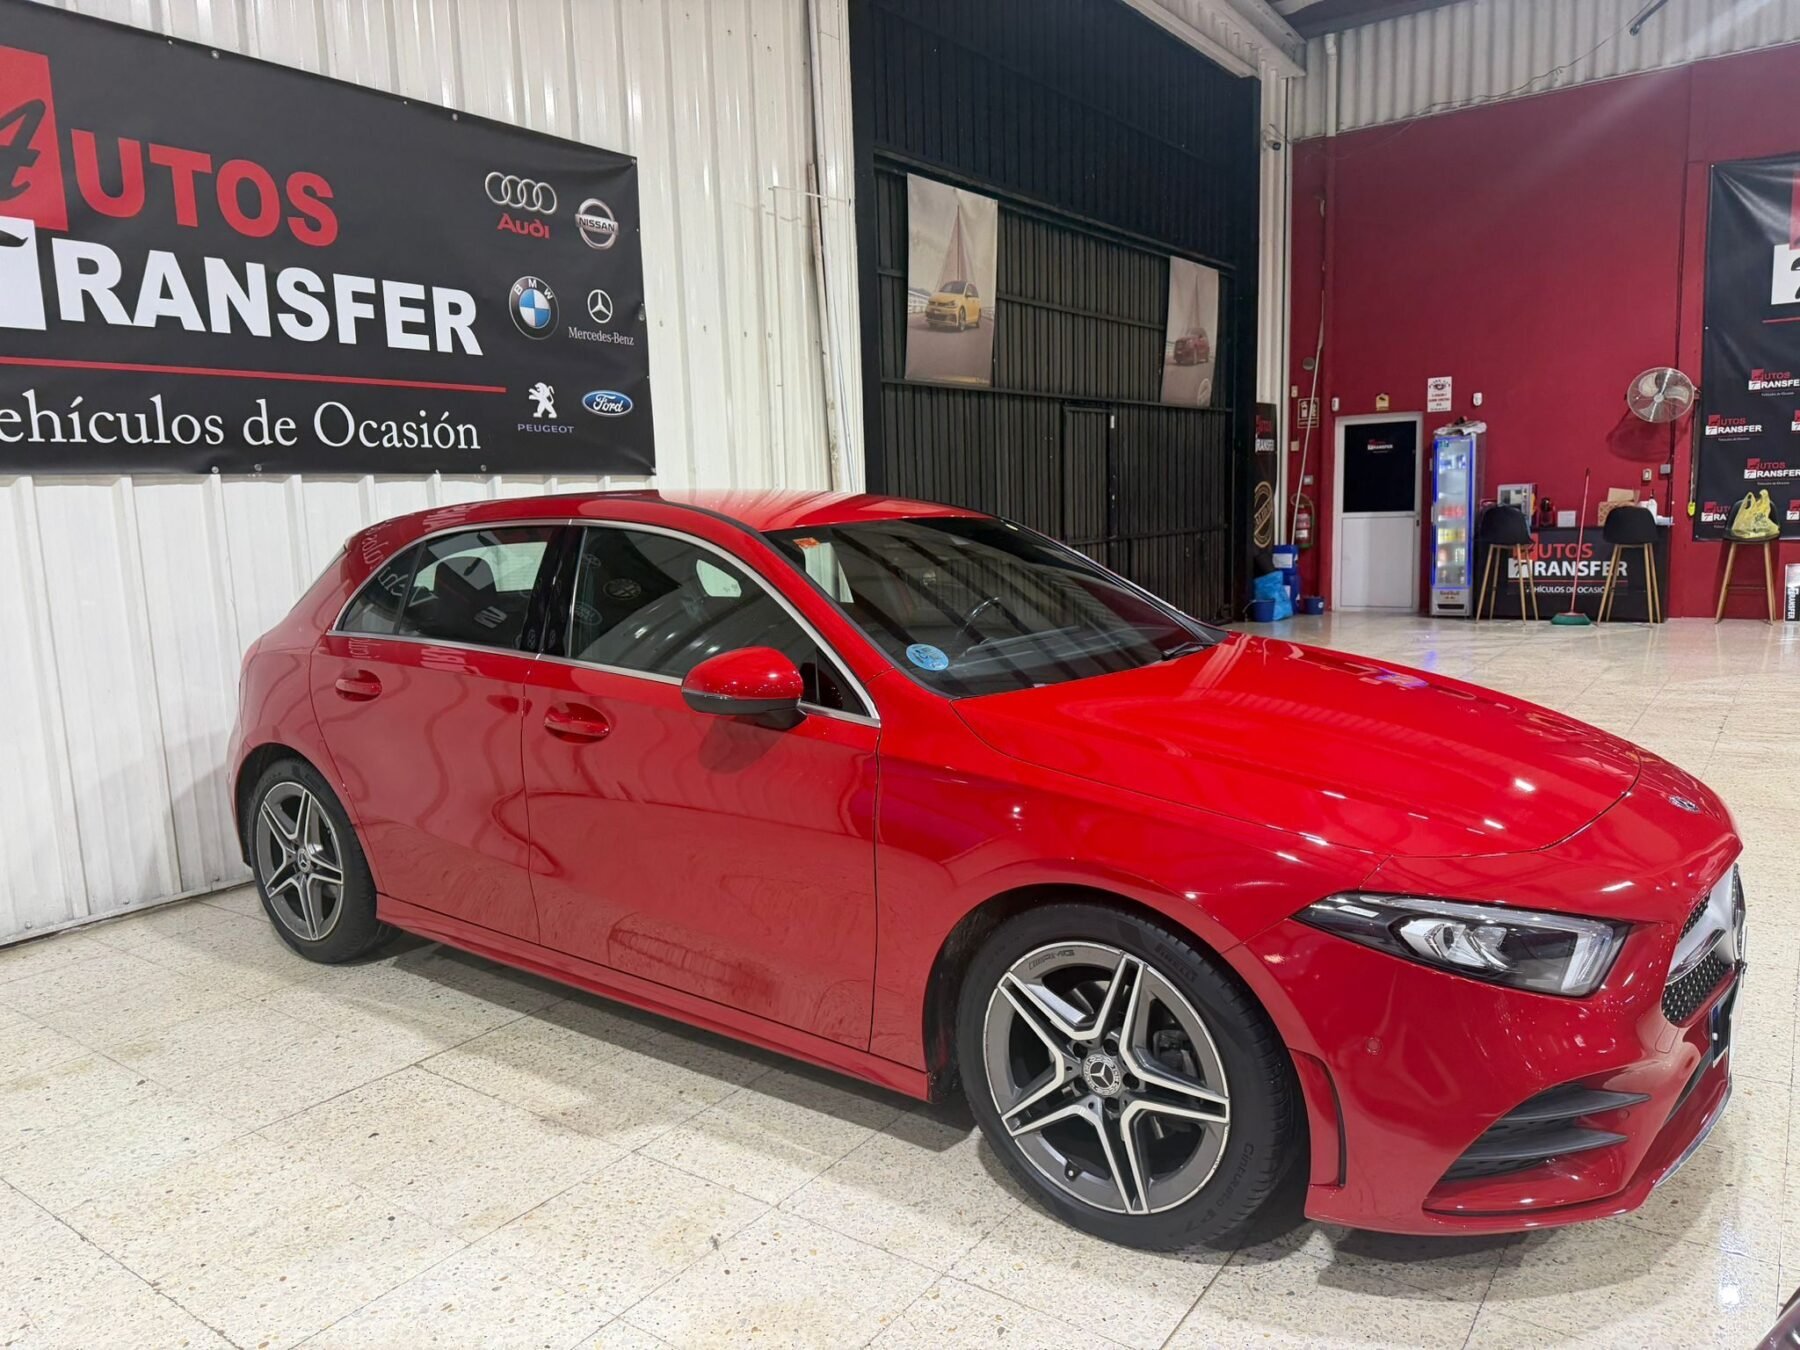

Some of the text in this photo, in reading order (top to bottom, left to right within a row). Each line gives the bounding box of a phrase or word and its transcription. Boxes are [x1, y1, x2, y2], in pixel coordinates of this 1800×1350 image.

[496, 212, 550, 240] Audi
[578, 216, 616, 233] NISSAN
[0, 220, 484, 357] RANSFER
[513, 278, 554, 300] BMW
[567, 326, 635, 346] Mercedes-Benz
[592, 394, 624, 413] Ford
[0, 389, 481, 450] ehículos de Ocasión
[517, 423, 575, 434] PEUGEOT
